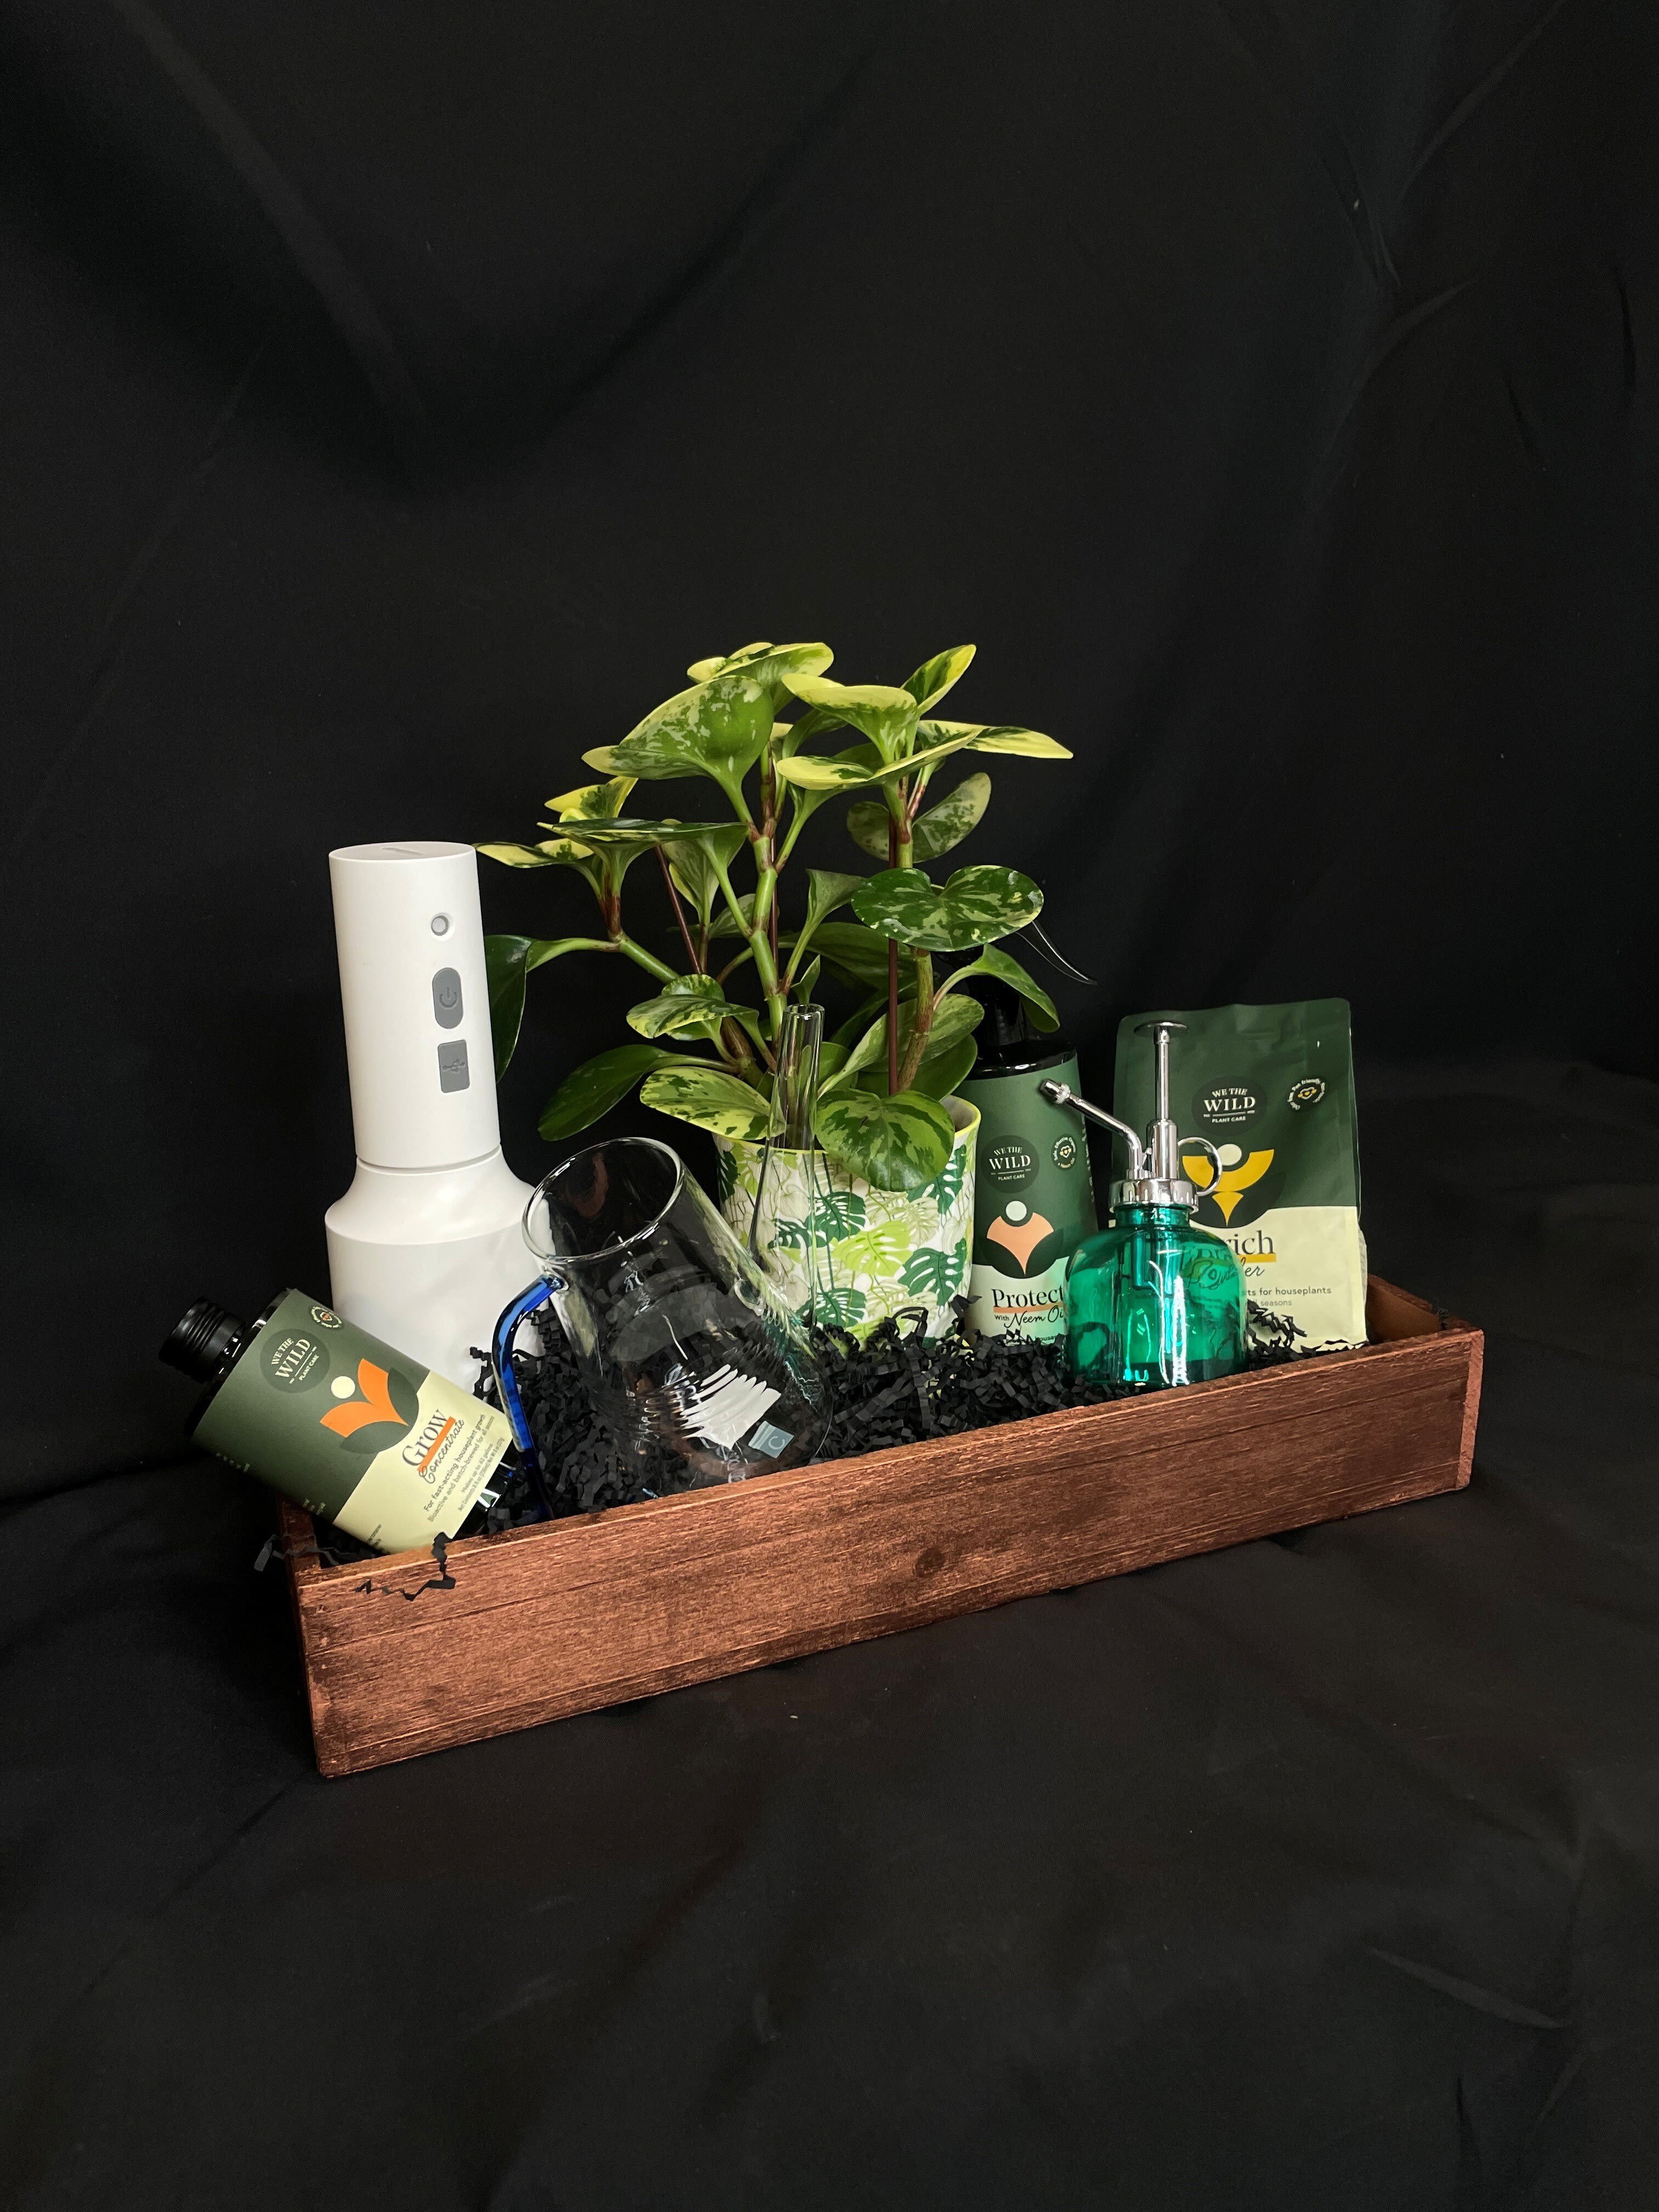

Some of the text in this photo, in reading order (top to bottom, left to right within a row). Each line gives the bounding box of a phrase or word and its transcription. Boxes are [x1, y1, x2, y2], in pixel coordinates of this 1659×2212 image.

[1212, 1088, 1227, 1098] WE
[1204, 1096, 1256, 1112] WILD
[994, 1147, 1007, 1156] WE
[989, 1154, 1031, 1170] WILD
[991, 1284, 1063, 1308] Protect
[1276, 1286, 1331, 1297] houseplants
[1003, 1311, 1046, 1328] Neem
[271, 1338, 294, 1364] WE THE
[275, 1339, 311, 1378] WILD
[298, 1365, 311, 1381] PLANT
[309, 1354, 319, 1367] CARE
[402, 1409, 447, 1466] Grow
[419, 1419, 464, 1483] Concentrate
[424, 1499, 435, 1511] For
[431, 1463, 459, 1499] fast-acting
[454, 1430, 477, 1462] houseplant
[446, 1482, 456, 1496] and
